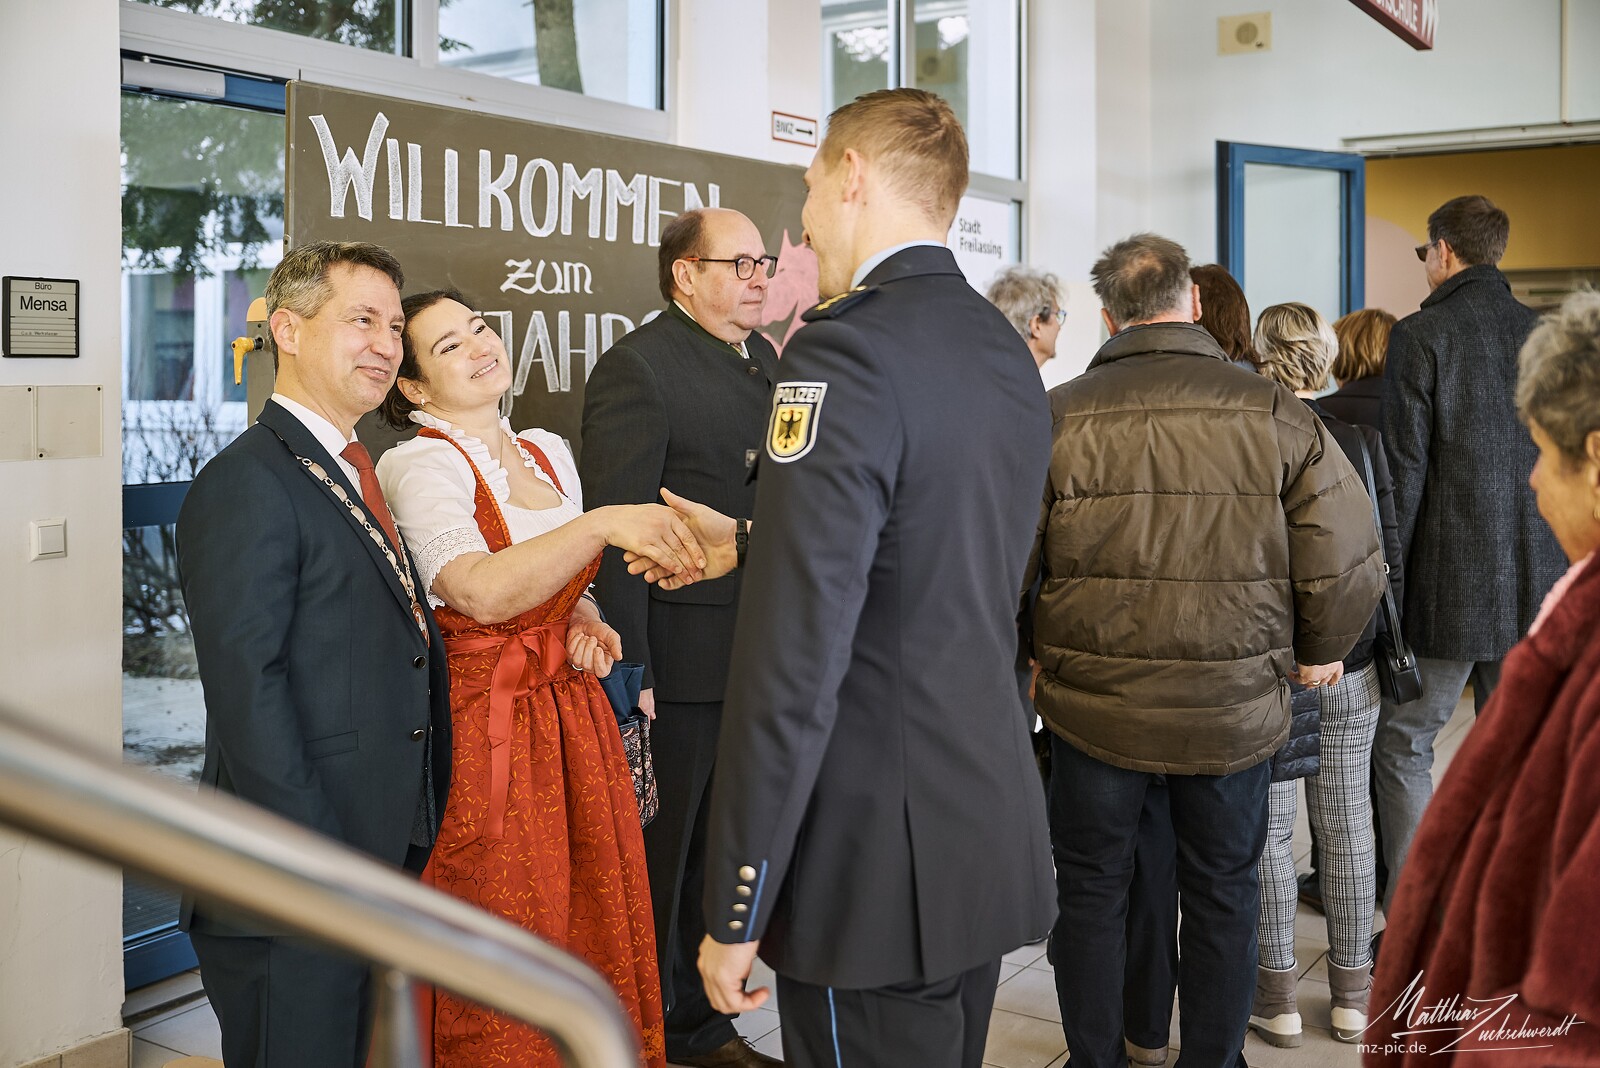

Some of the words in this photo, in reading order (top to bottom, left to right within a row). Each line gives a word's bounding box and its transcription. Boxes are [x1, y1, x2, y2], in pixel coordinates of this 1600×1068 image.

[960, 218, 981, 234] Stadt
[960, 237, 1002, 259] Freilassing
[34, 282, 52, 290] Büro
[20, 295, 68, 311] Mensa
[776, 387, 821, 403] POLIZEI
